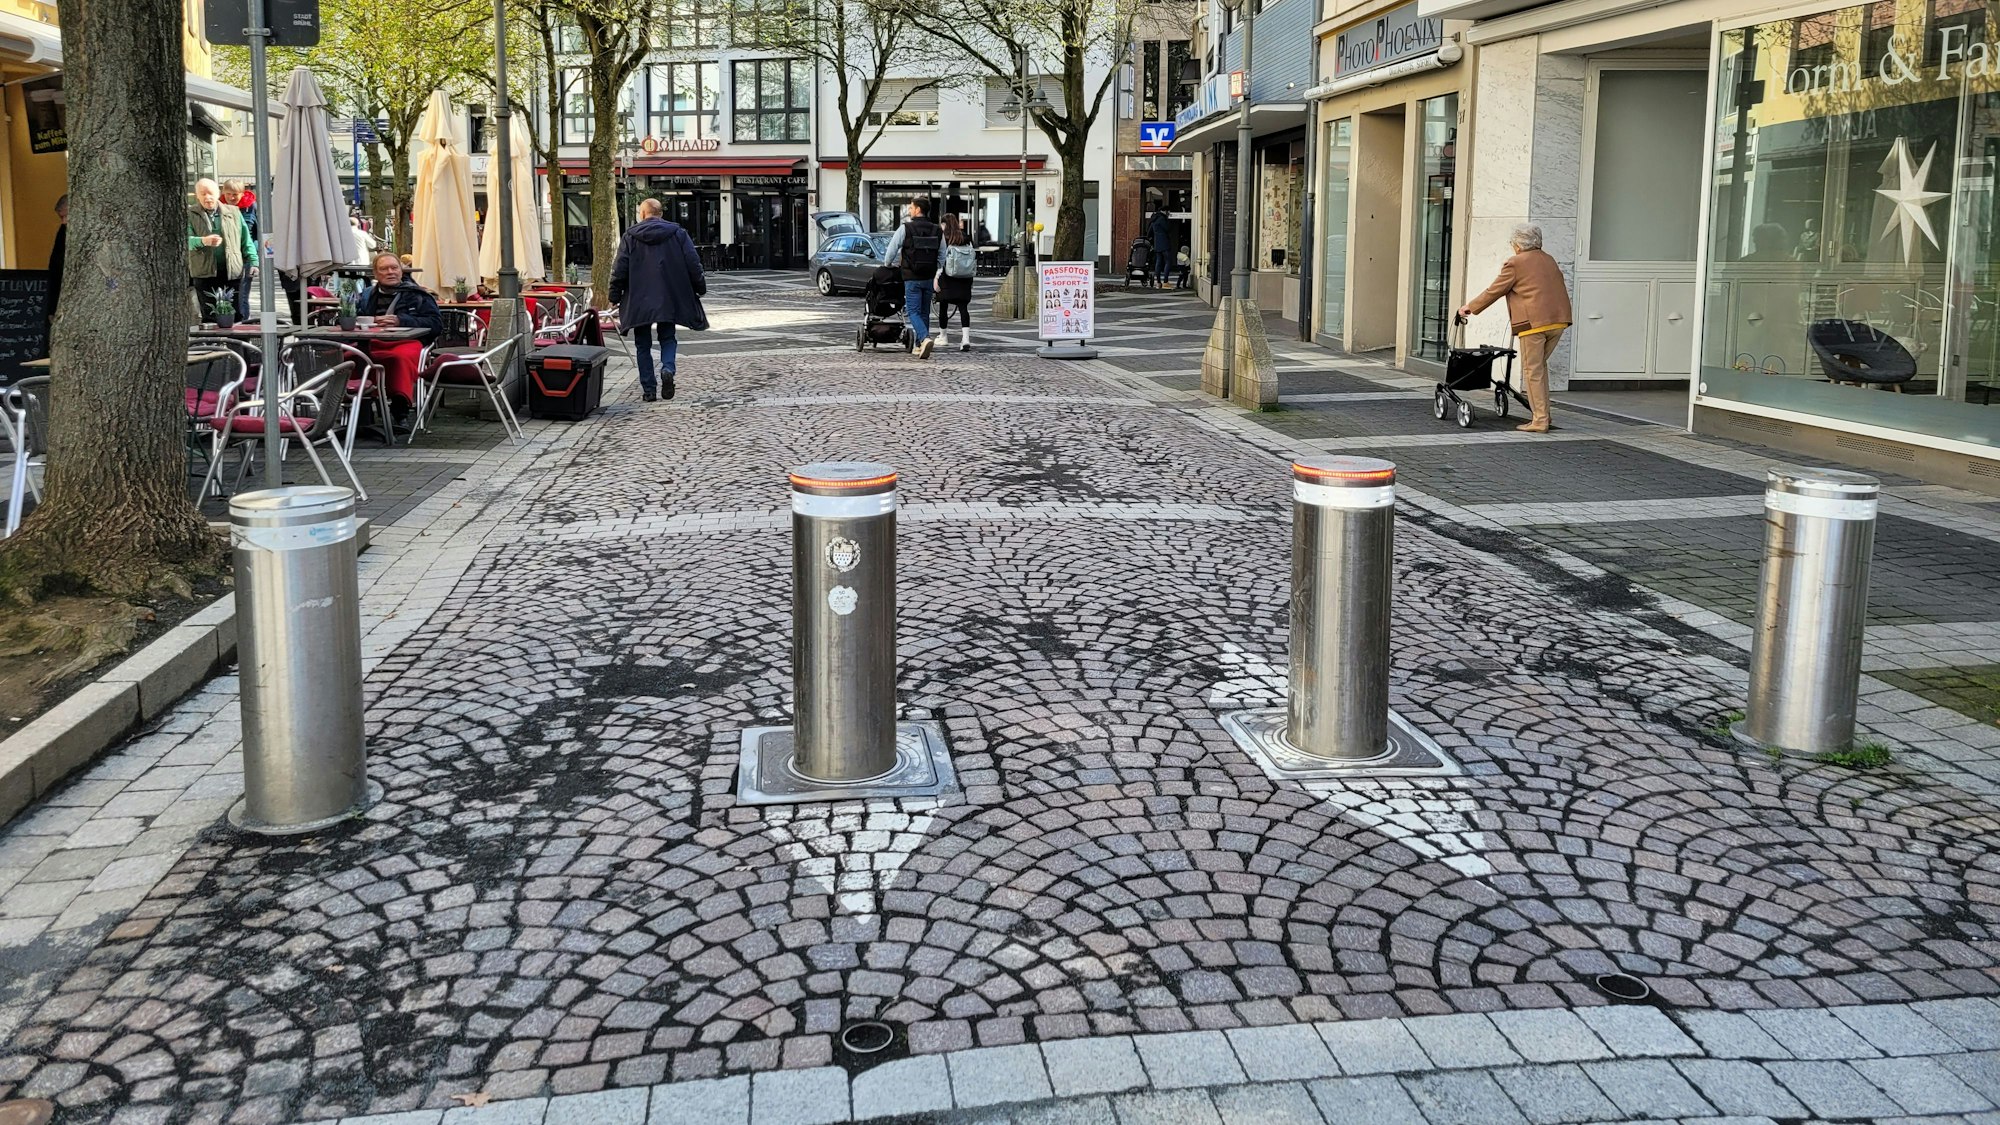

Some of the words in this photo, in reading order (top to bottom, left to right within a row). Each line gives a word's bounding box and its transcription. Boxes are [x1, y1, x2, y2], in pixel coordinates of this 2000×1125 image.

[1879, 33, 1922, 86] &
[1936, 24, 2000, 82] Fa
[737, 176, 782, 185] RESTAURANT
[1044, 266, 1089, 276] PASSFOTOS
